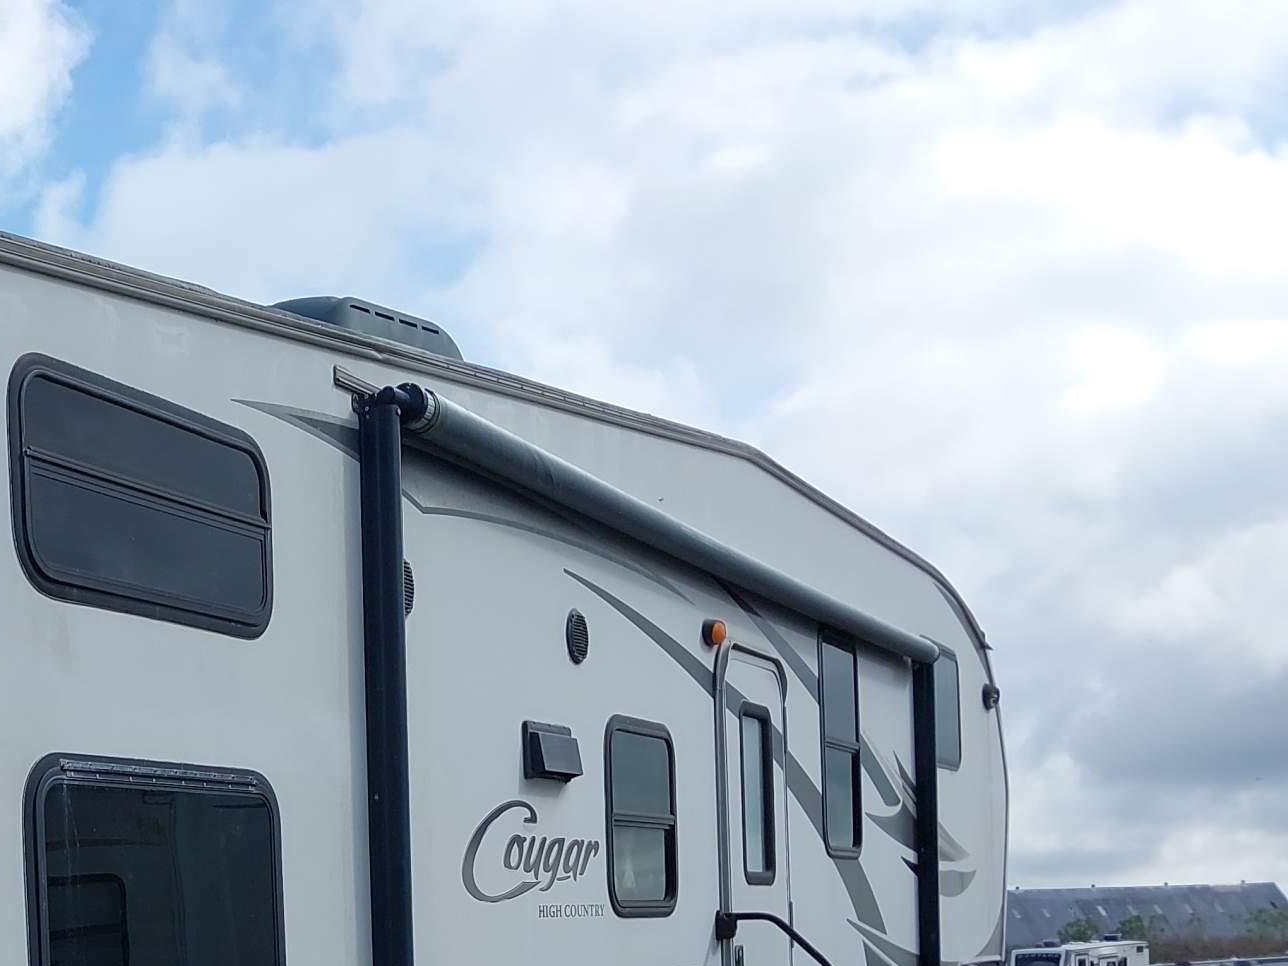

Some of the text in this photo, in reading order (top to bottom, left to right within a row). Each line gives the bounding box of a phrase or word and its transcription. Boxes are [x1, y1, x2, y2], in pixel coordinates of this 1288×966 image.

[462, 800, 600, 903] Cougar
[538, 903, 605, 918] HIGH COUNTRY
